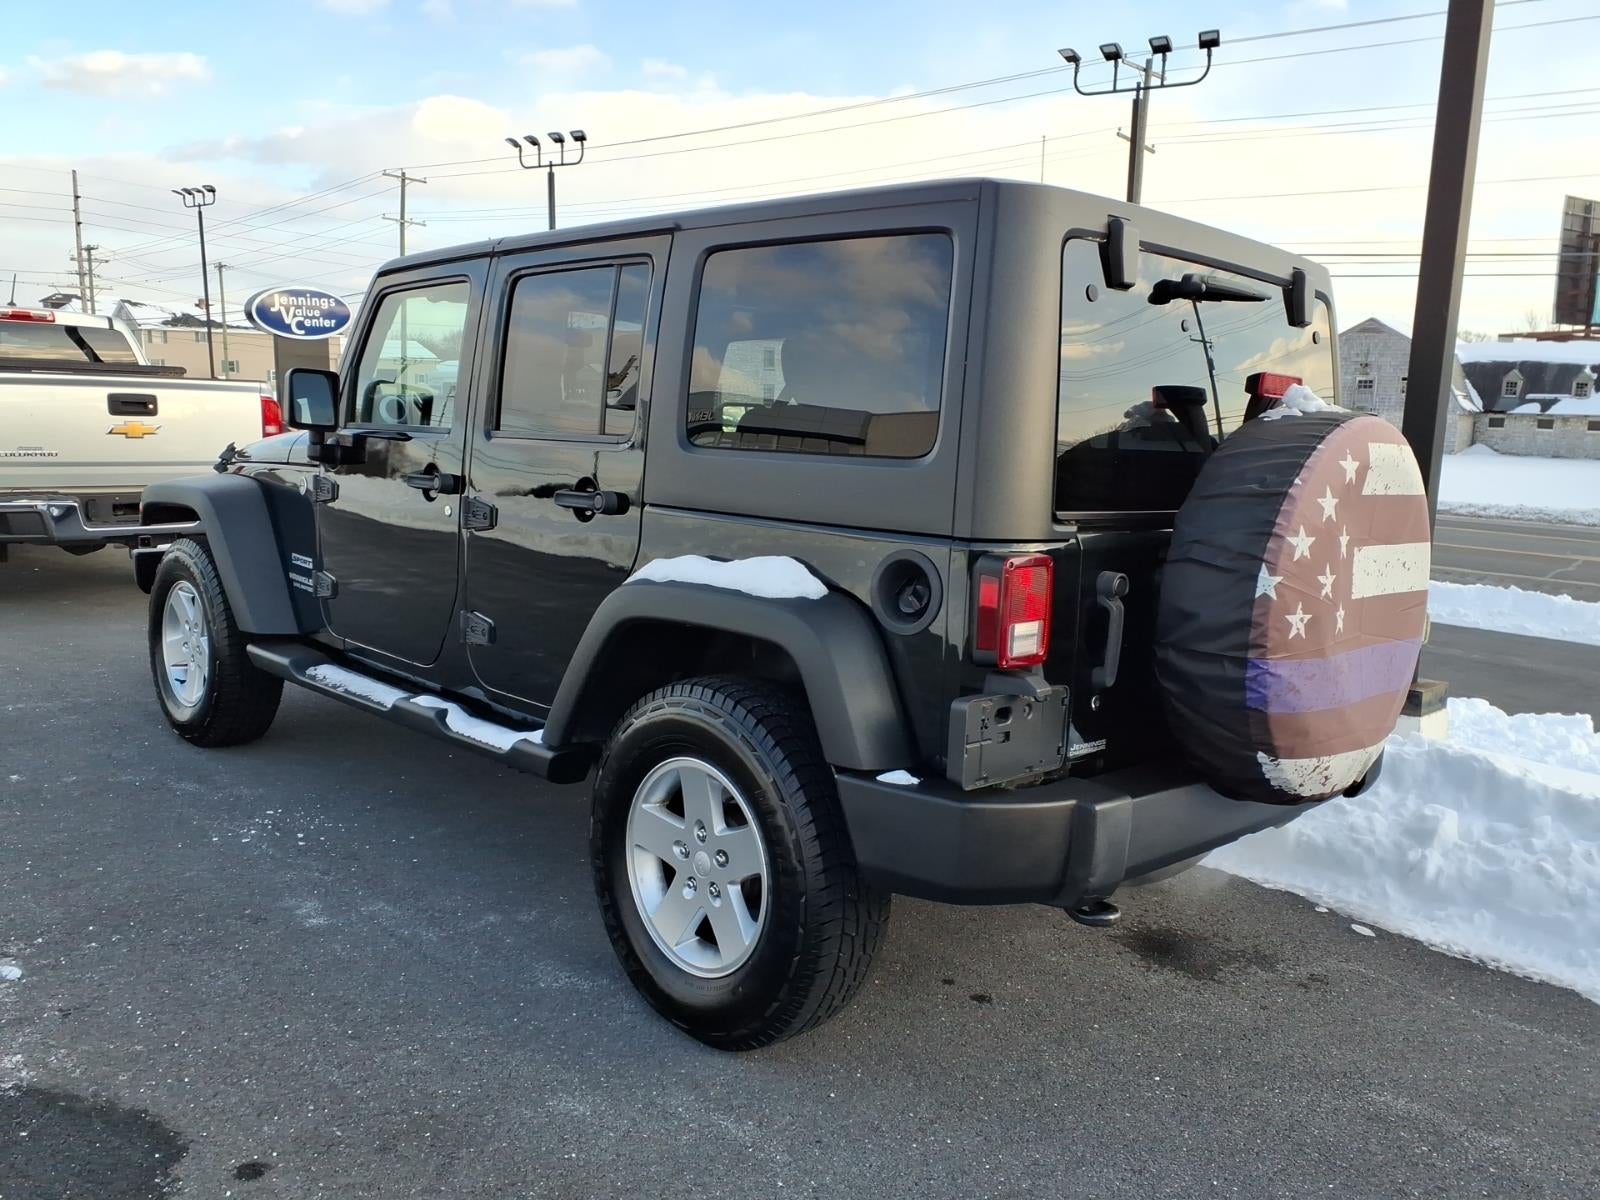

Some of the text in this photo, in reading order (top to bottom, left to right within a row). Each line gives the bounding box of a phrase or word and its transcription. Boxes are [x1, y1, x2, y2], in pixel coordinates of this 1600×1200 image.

[270, 293, 336, 312] Jennings
[279, 306, 321, 325] Value
[290, 316, 336, 335] Center
[292, 555, 313, 567] SPORT
